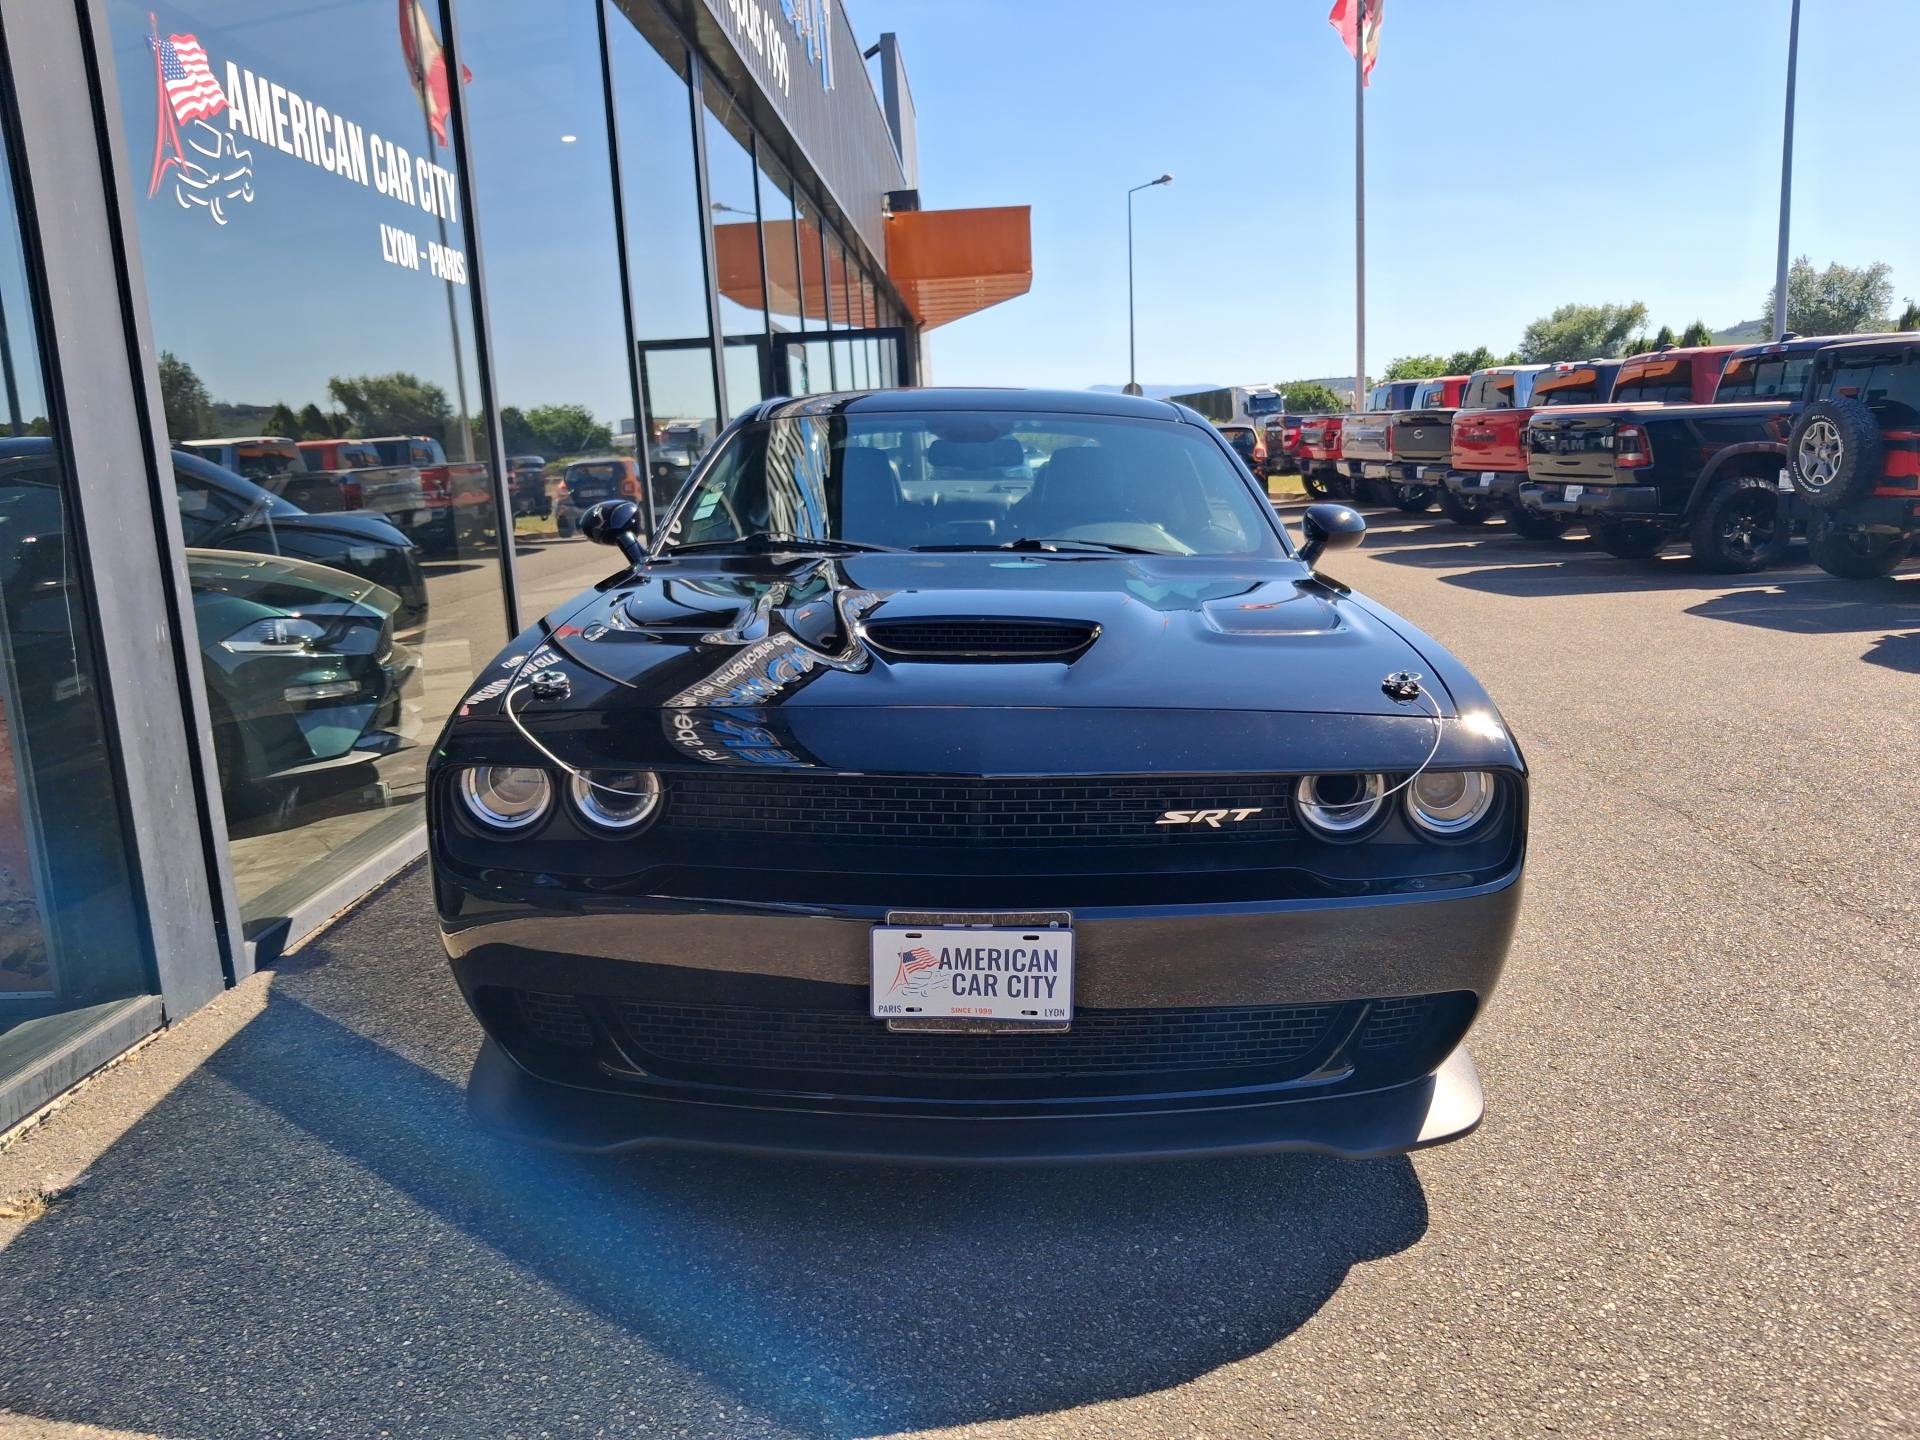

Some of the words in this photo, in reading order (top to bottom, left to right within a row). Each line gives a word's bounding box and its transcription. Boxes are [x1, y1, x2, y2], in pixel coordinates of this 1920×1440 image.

[764, 10, 790, 98] 1999
[225, 60, 369, 186] AMERICAN
[370, 133, 415, 206] CAR
[416, 156, 457, 223] CITY
[379, 223, 418, 271] LYON
[429, 242, 467, 286] PARIS
[1155, 807, 1263, 828] SRT
[939, 947, 1058, 973] AMERICAN
[952, 973, 998, 997] CAR
[1007, 975, 1058, 999] CITY
[878, 1004, 902, 1014] PARIS
[1044, 1008, 1065, 1018] LYON
